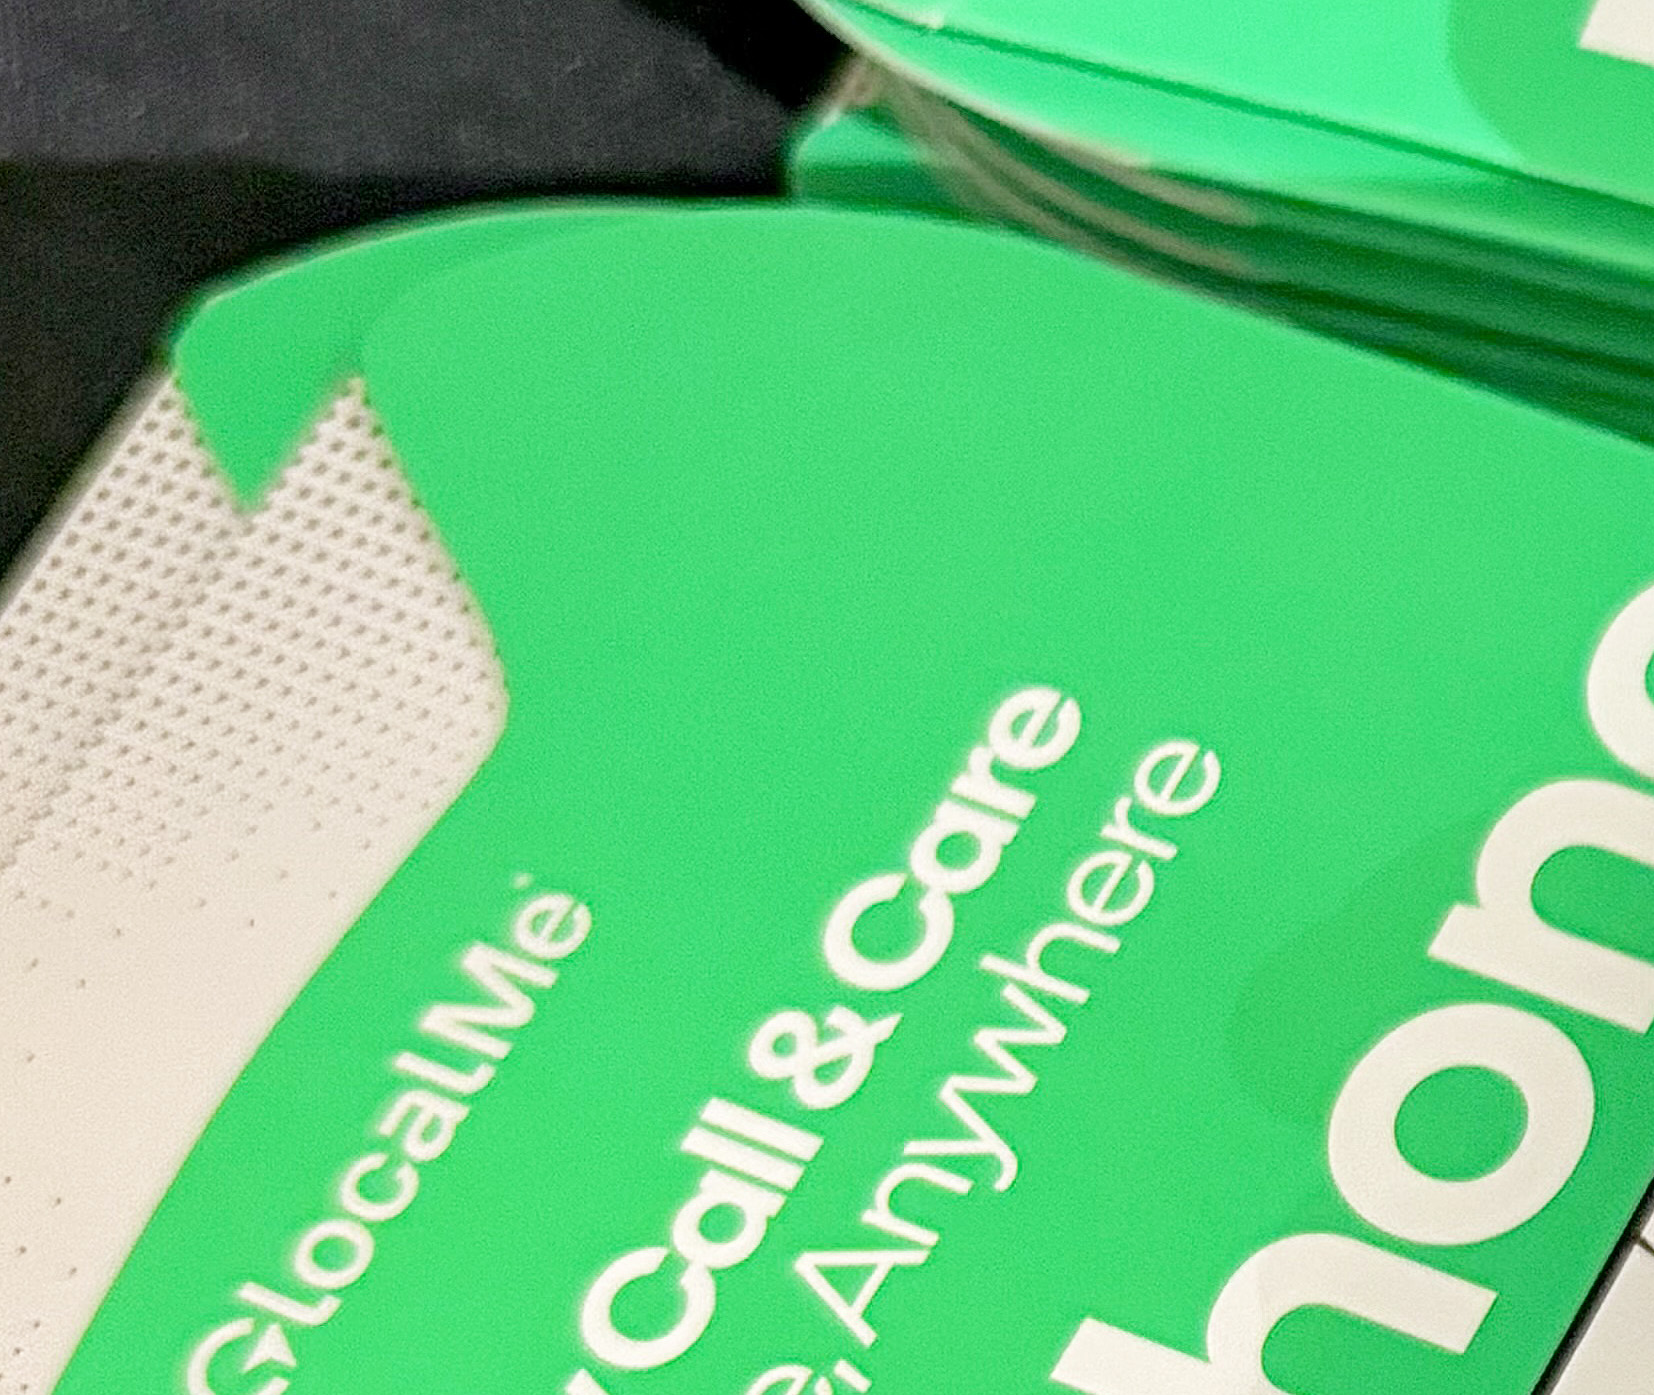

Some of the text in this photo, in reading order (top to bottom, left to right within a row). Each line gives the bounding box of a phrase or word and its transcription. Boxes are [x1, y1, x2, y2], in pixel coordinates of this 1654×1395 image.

[819, 685, 1083, 992] Care
[745, 1004, 903, 1111] &
[790, 738, 1223, 1348] Anywhere
[577, 1096, 825, 1371] Call
